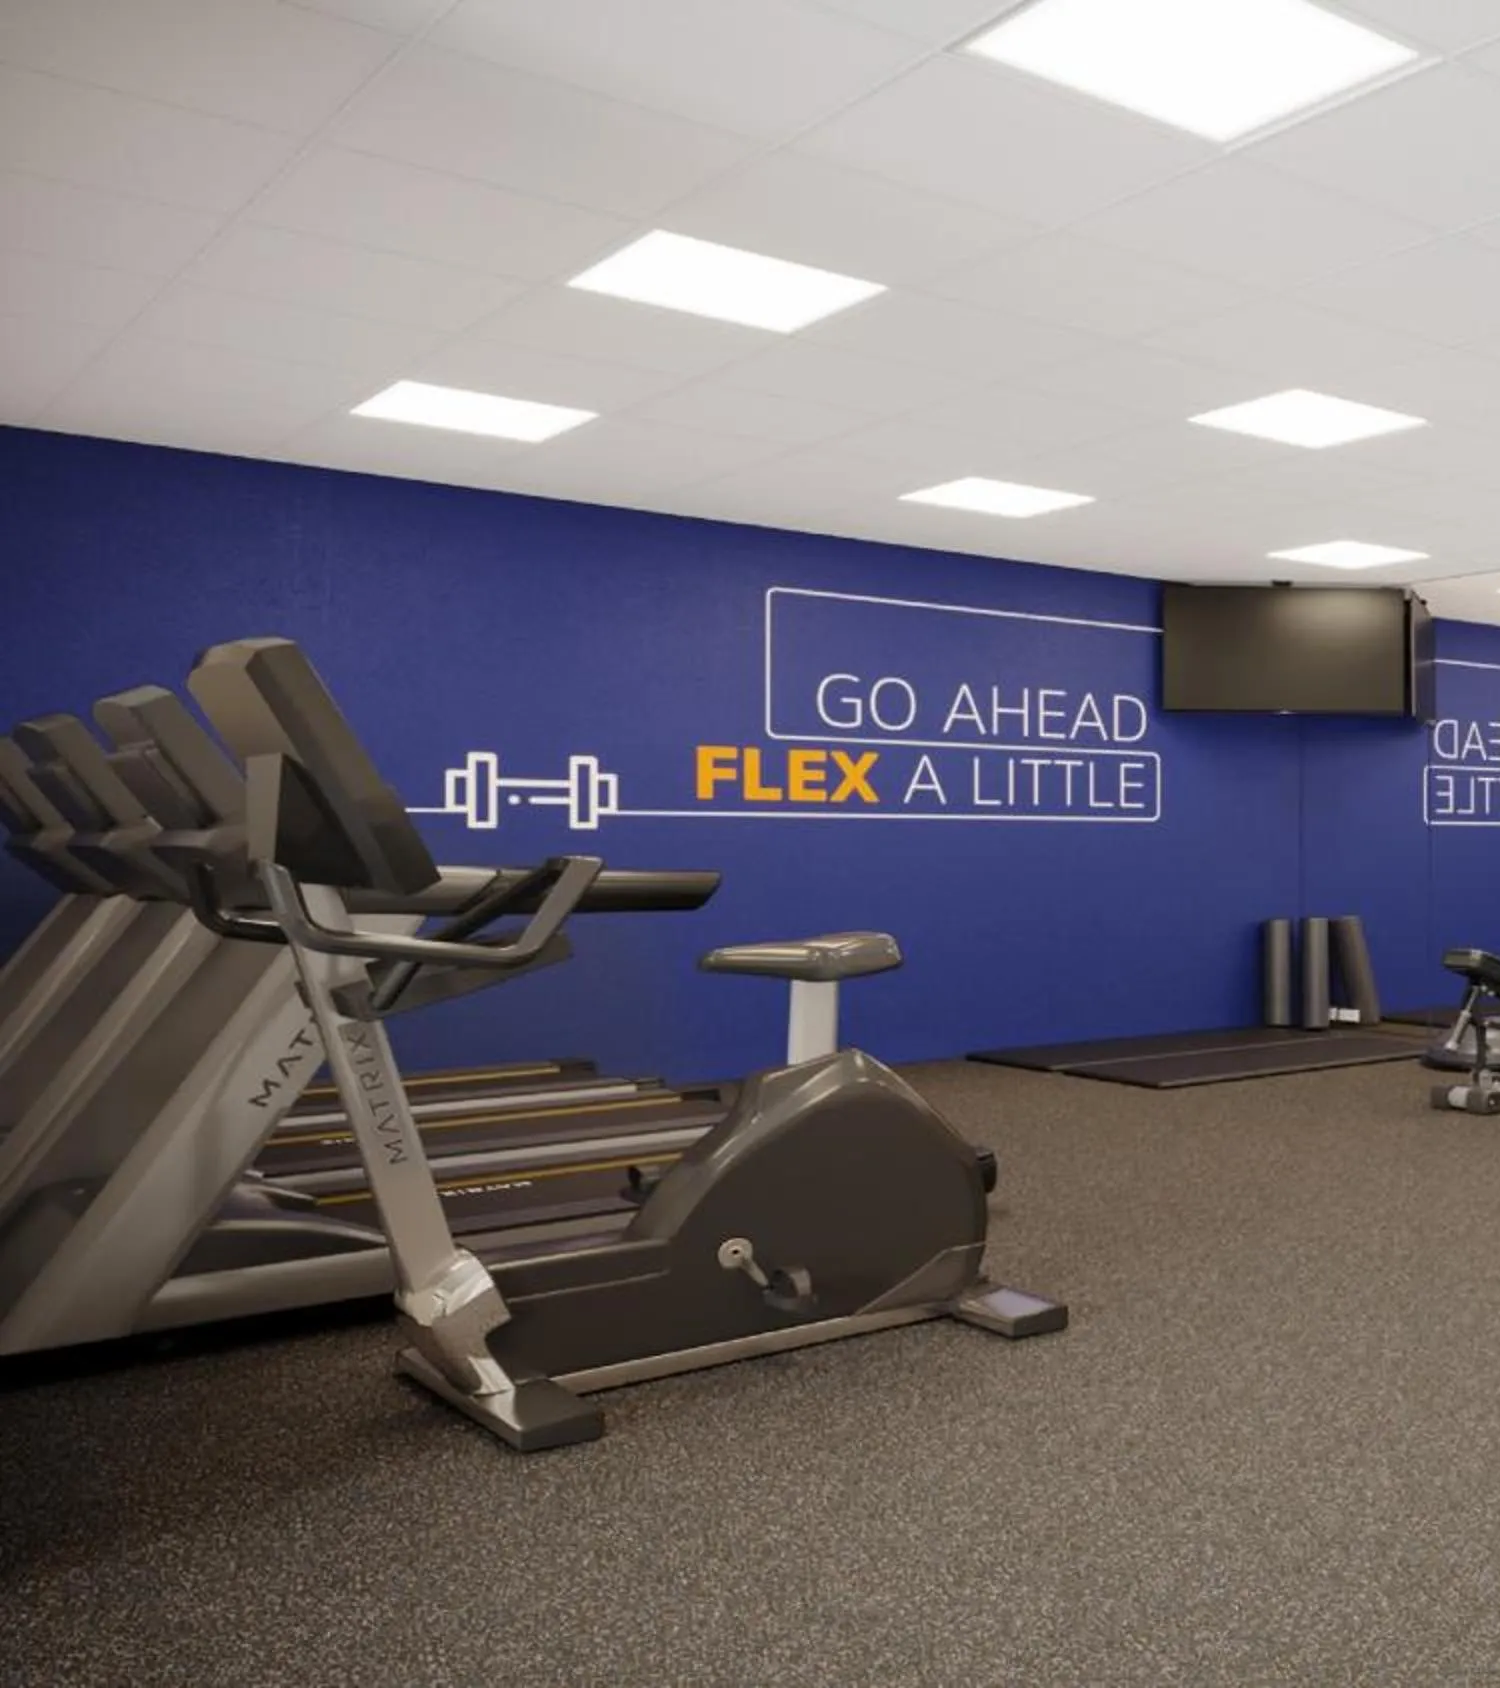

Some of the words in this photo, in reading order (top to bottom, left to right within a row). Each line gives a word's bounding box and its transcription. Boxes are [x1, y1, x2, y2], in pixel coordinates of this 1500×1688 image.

[816, 673, 917, 731] GO
[942, 683, 1147, 743] AHEAD
[696, 745, 878, 803] FLEX
[903, 754, 947, 805] A
[973, 756, 1145, 809] LITTLE
[248, 1017, 315, 1107] MAT
[347, 1033, 408, 1166] MATRIX
